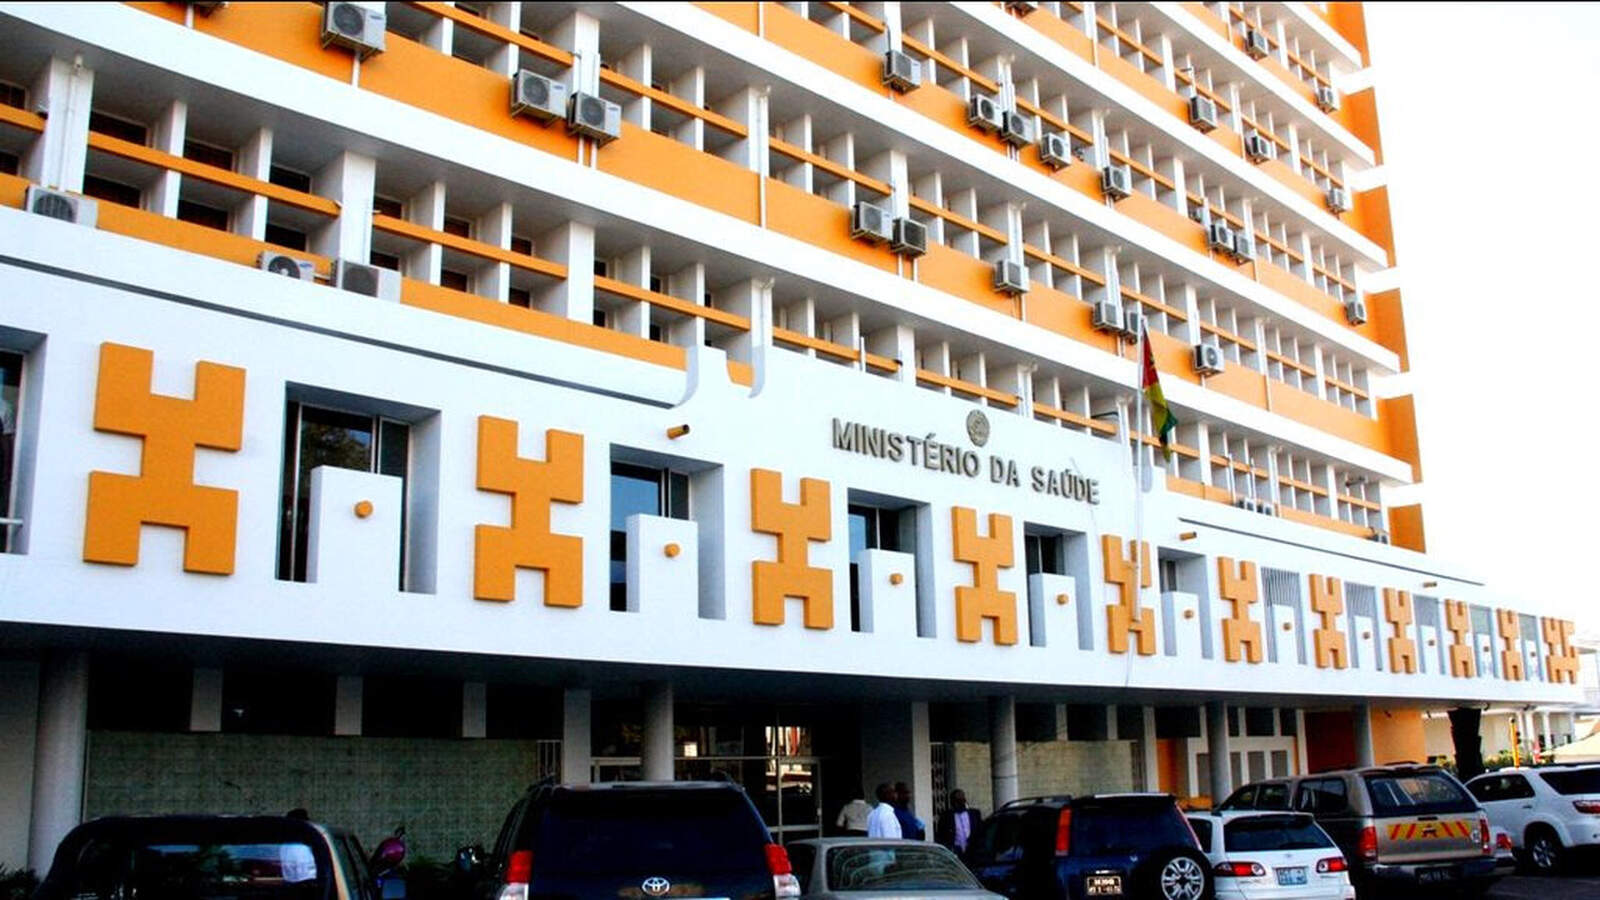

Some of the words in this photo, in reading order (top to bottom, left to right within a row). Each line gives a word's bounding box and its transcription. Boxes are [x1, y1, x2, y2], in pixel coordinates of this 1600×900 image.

[832, 417, 979, 478] MINISTÉRIO
[990, 455, 1020, 487] DA
[1031, 466, 1100, 505] SAÚDE
